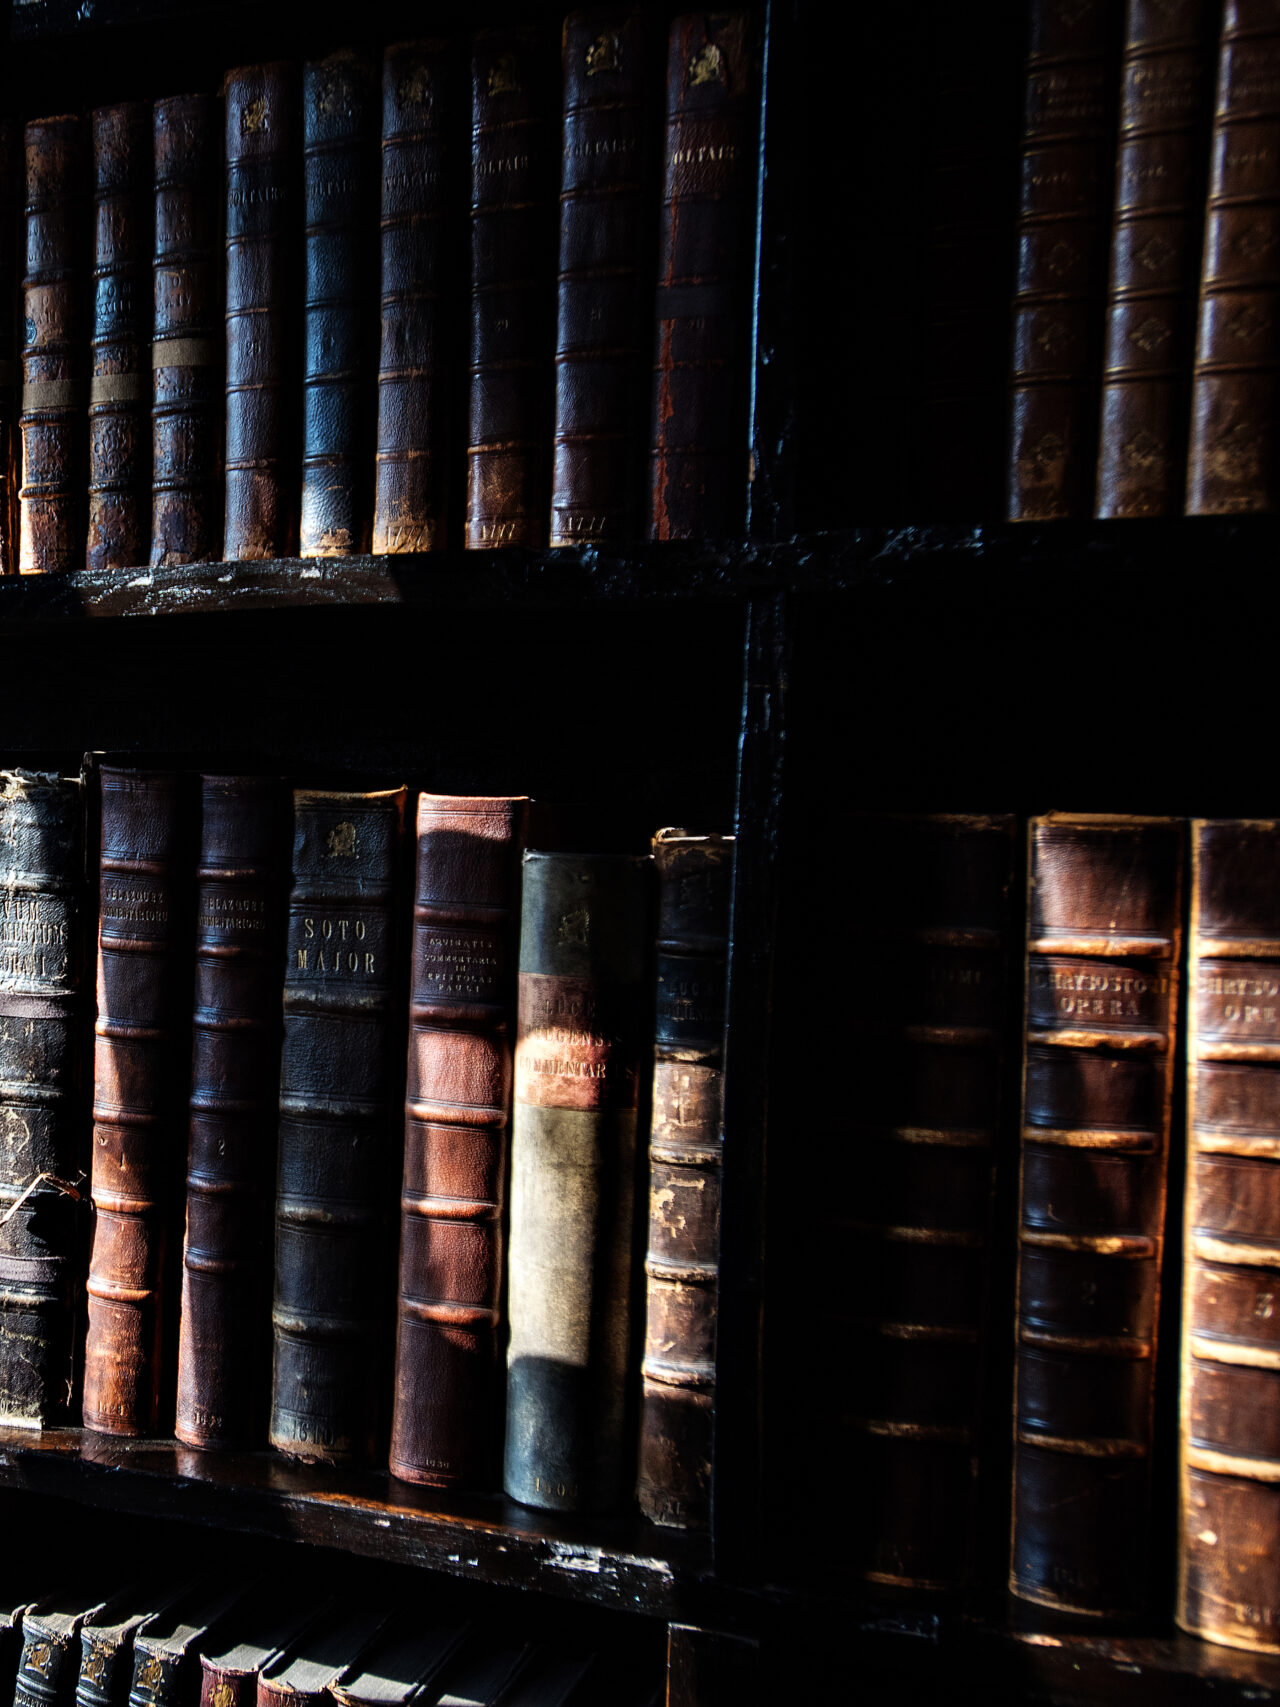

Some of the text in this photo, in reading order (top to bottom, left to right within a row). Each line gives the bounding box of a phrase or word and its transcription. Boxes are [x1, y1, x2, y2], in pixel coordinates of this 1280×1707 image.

[304, 917, 367, 941] SOTO
[297, 948, 377, 975] MAJOR
[1059, 996, 1141, 1017] OPERA
[1254, 1291, 1274, 1320] 3
